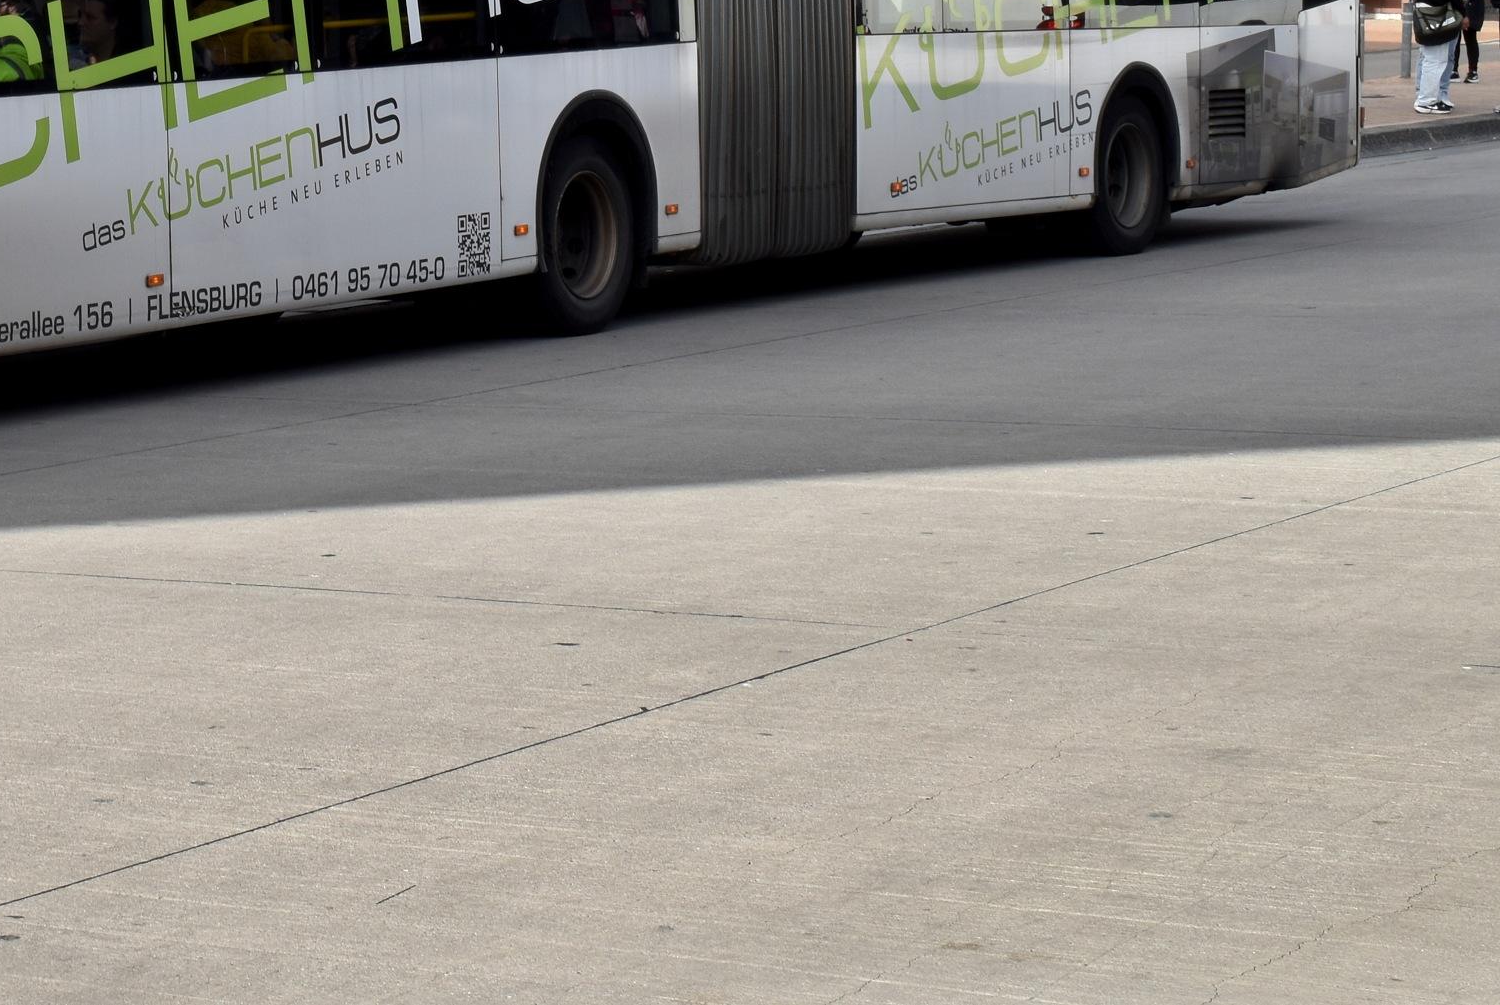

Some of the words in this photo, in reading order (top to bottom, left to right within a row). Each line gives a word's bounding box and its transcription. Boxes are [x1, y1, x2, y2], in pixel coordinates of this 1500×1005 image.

[222, 196, 279, 230] KÜCHE
[290, 179, 322, 205] NEU
[334, 150, 405, 189] ERLEBEN
[977, 162, 1014, 187] KÜCHE
[1021, 151, 1042, 169] NEU
[1049, 134, 1095, 160] ERLEBEN
[73, 300, 114, 332] 156
[148, 281, 262, 322] FLENSBURG
[292, 270, 339, 301] 0461
[347, 266, 371, 293] 95
[377, 262, 401, 289] 70
[406, 256, 445, 284] 45-0
